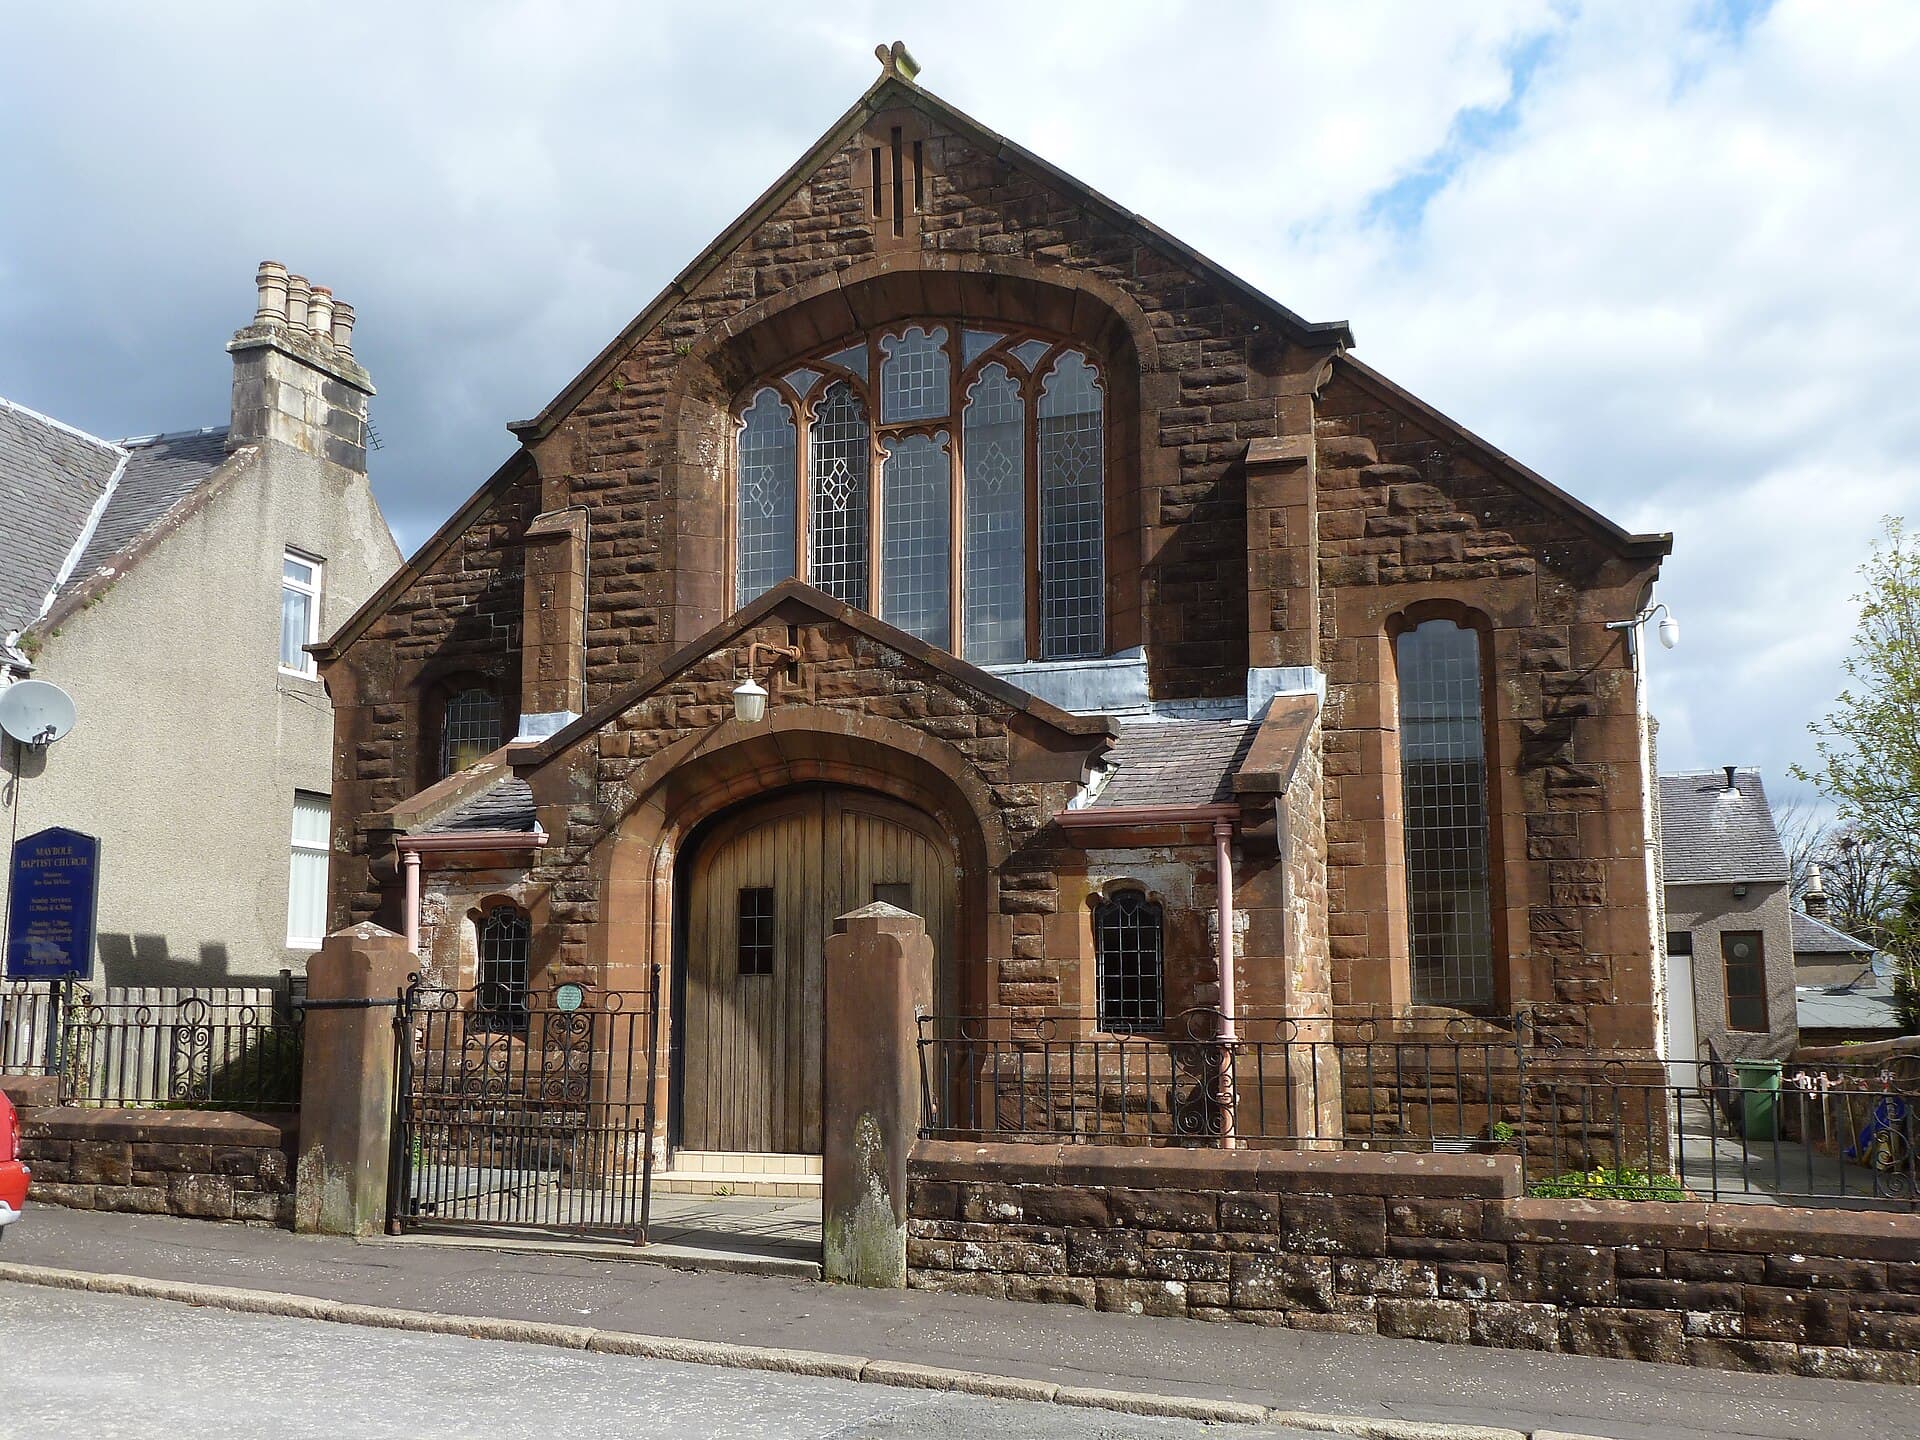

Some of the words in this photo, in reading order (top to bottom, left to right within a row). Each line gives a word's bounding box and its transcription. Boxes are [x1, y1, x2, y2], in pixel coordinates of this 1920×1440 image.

[35, 847, 73, 856] MAYBOLE
[20, 859, 52, 868] BAPTIST
[54, 857, 88, 867] CHURCH
